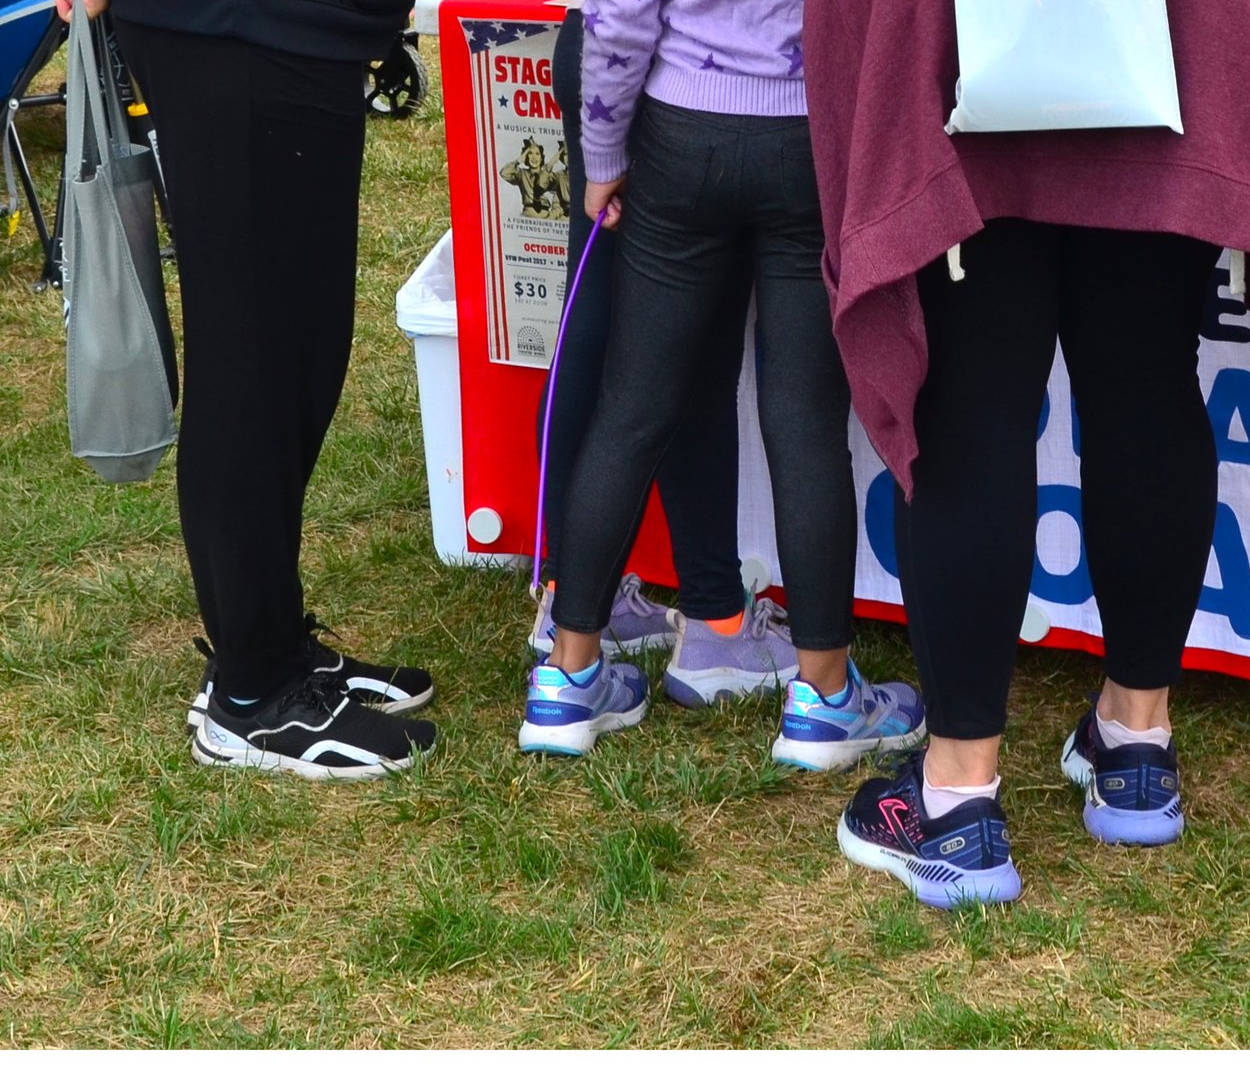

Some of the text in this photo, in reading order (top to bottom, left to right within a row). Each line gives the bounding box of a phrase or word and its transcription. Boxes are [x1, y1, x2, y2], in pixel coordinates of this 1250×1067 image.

[495, 55, 551, 86] STAG
[504, 124, 536, 133] MUSICAL
[513, 218, 553, 227] FUNDRAISING
[524, 243, 565, 255] OCTOBER
[515, 281, 547, 299] $30
[517, 343, 545, 352] RIVERSIDE
